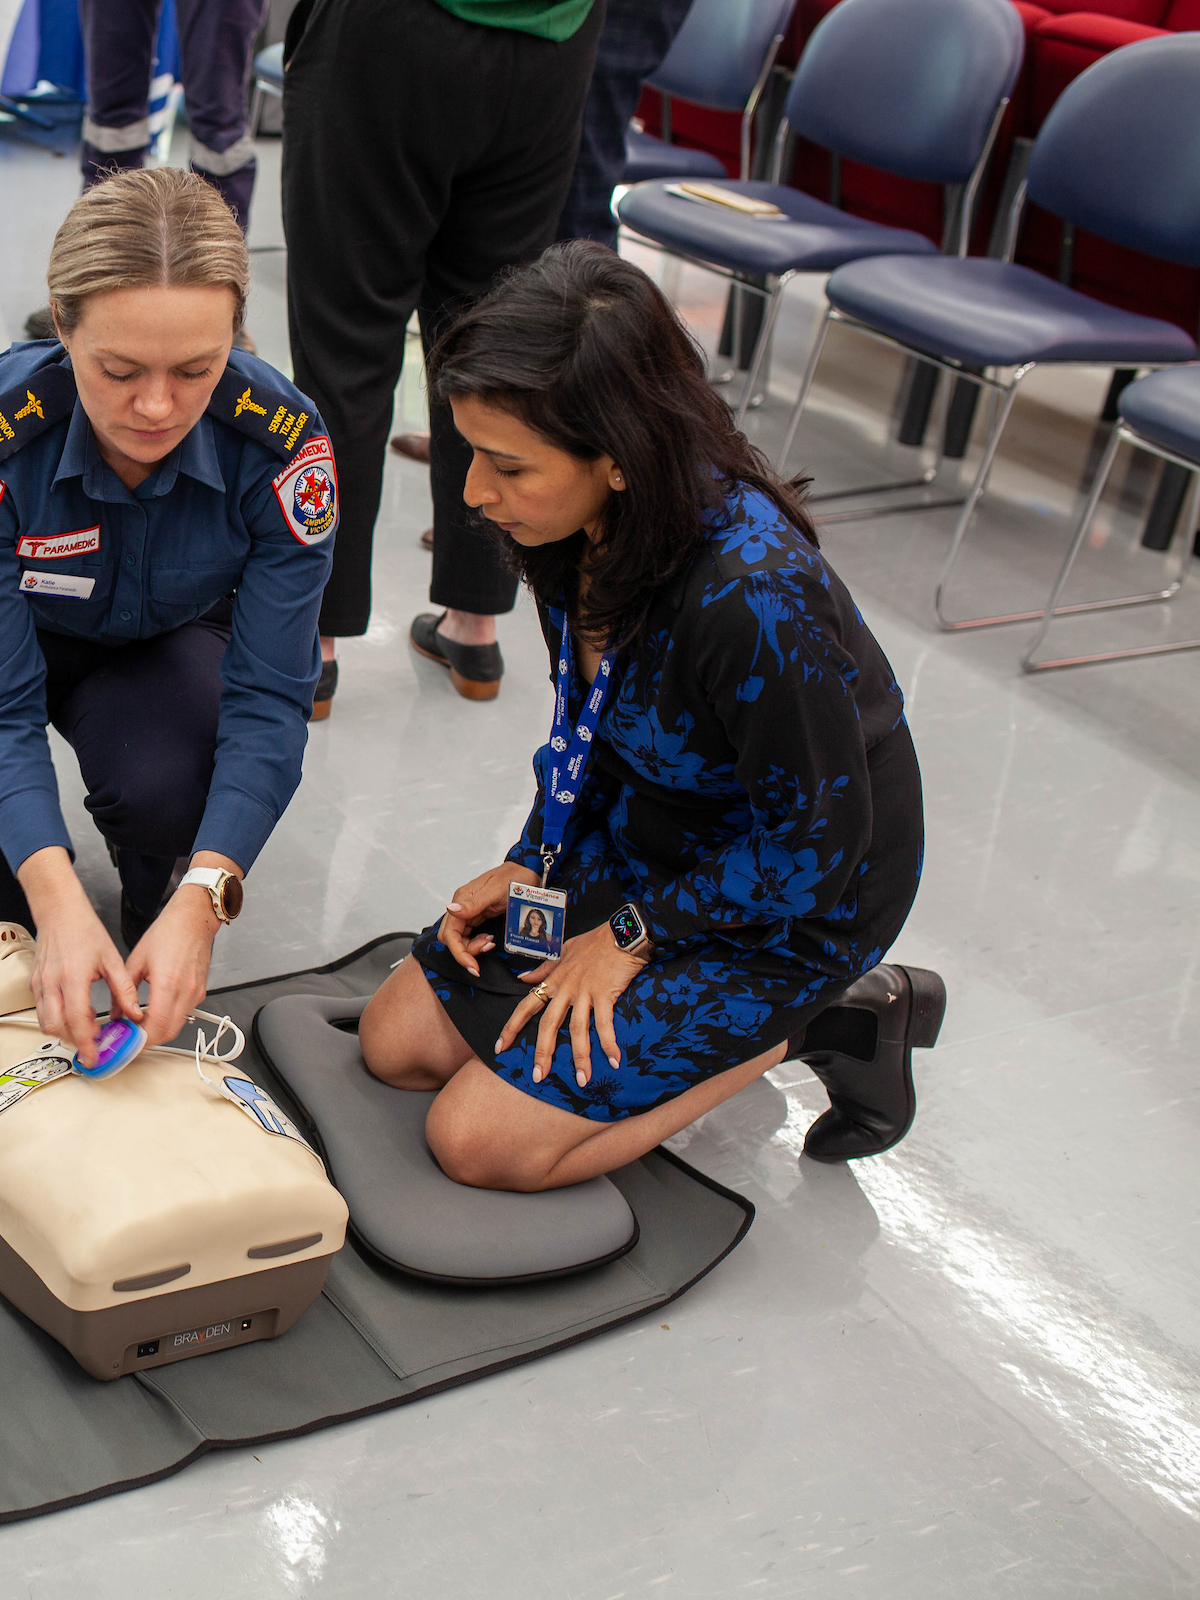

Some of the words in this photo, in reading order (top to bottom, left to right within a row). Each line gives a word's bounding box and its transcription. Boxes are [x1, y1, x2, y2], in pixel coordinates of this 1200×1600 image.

[268, 405, 288, 434] SENIOR
[278, 413, 296, 436] TEAM
[284, 411, 309, 451] MANAGER
[43, 538, 96, 555] PARAMEDIC
[525, 888, 560, 900] Ambulance
[525, 893, 549, 902] Victoria
[174, 1322, 231, 1346] BRAYDEN
